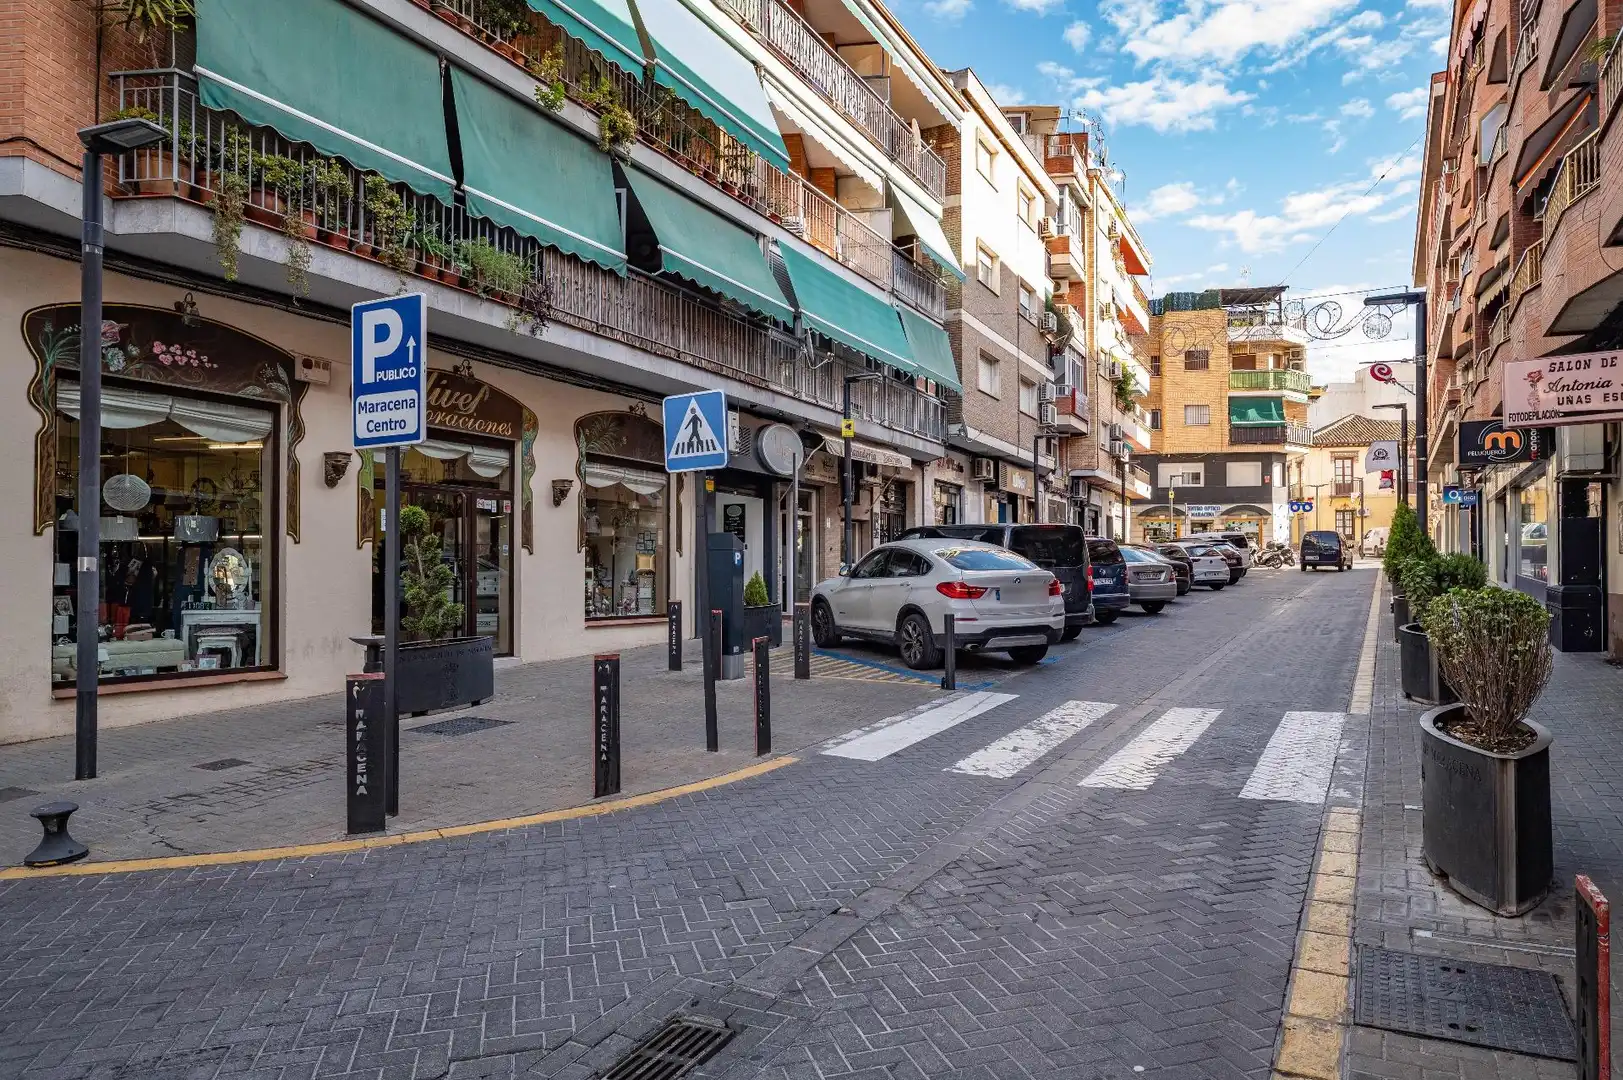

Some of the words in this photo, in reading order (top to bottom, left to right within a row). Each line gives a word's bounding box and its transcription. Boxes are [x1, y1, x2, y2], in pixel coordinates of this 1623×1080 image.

[362, 308, 403, 385] P
[1548, 359, 1592, 373] SALON
[1600, 356, 1618, 368] DE
[376, 366, 417, 382] PUBLICO
[1543, 377, 1613, 393] Antonia
[358, 398, 416, 414] Maracena
[1557, 394, 1592, 406] UÑAS
[1603, 392, 1623, 402] ES
[366, 418, 406, 433] Centro
[427, 409, 512, 436] oraciones
[1467, 449, 1507, 457] PELUQUEROS
[734, 552, 742, 565] P
